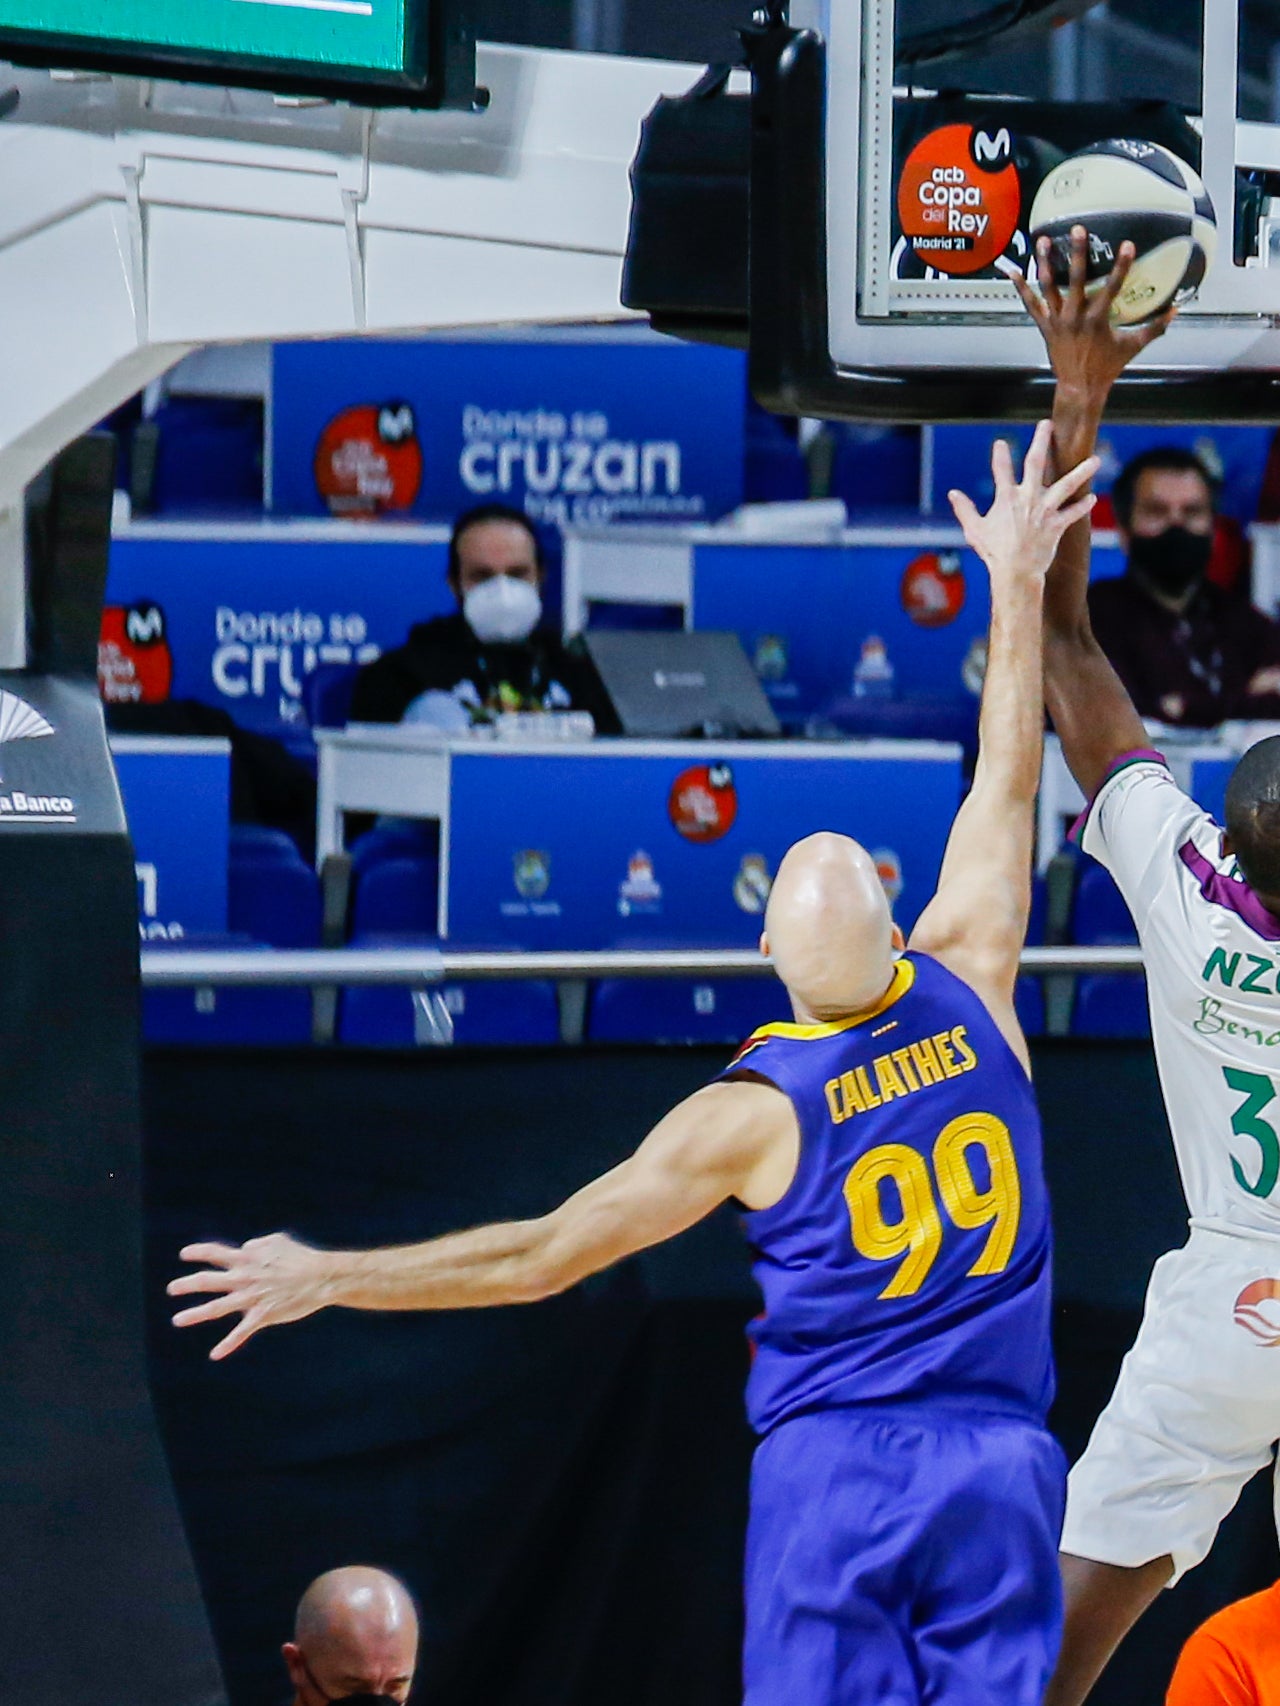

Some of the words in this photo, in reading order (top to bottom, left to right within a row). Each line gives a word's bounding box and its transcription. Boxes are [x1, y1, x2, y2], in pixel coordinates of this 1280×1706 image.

[932, 166, 965, 183] acb
[919, 181, 981, 208] Copa
[948, 210, 989, 236] Rey
[912, 236, 952, 249] Madrid
[463, 404, 567, 439] Donde
[459, 440, 682, 493] cruzan
[216, 605, 324, 642] Donde
[330, 612, 367, 644] se
[824, 1025, 977, 1125] CALATHES
[842, 1111, 1021, 1300] 99
